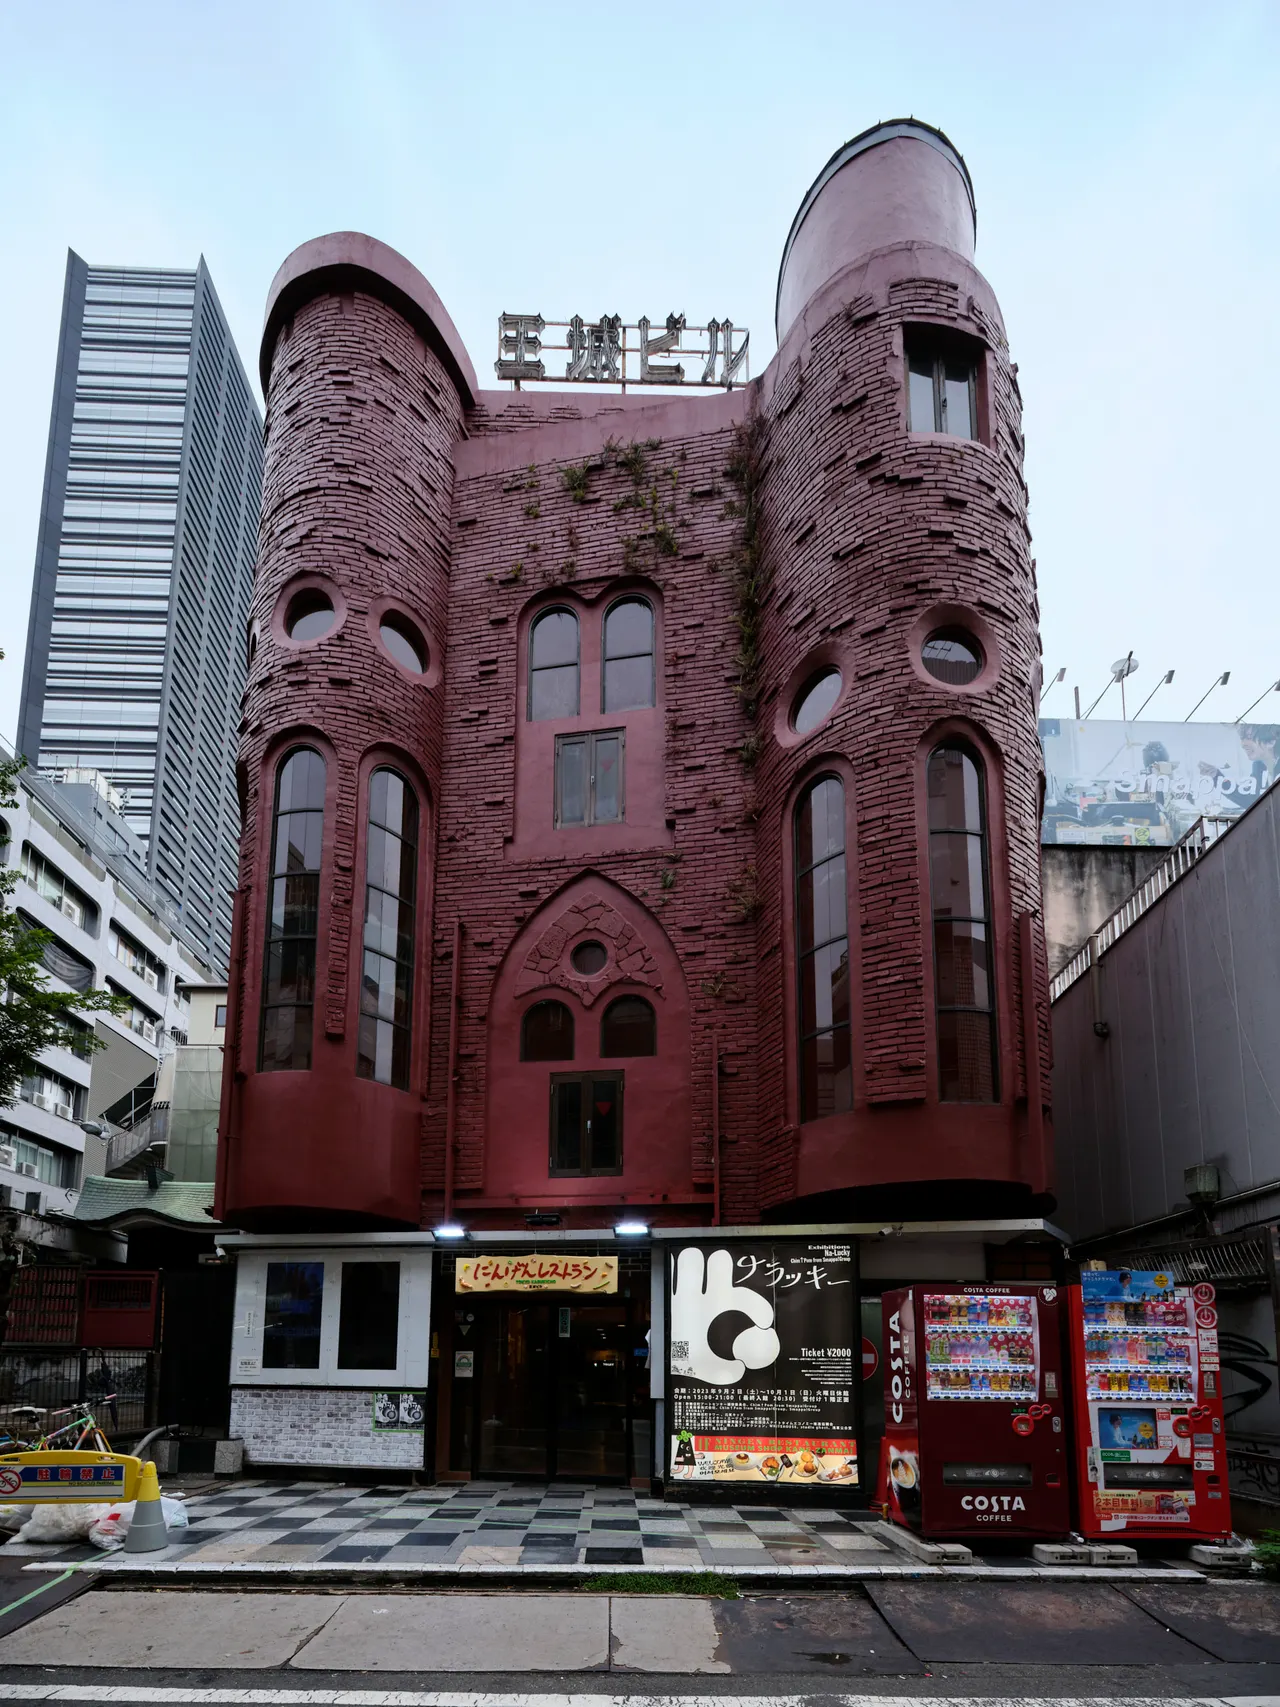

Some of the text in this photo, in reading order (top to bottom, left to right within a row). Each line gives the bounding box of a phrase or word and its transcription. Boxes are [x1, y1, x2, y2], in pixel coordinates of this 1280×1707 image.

[494, 311, 750, 386] 王城ビル
[1115, 769, 1280, 800] Smappa!
[824, 1249, 850, 1257] Na-Lucky
[473, 1261, 598, 1281] にんげんレストラン
[734, 1255, 850, 1290] ナラッキー
[801, 1347, 852, 1357] Ticket ¥2000
[889, 1310, 903, 1424] COSTA
[903, 1334, 912, 1399] COFFEE
[715, 1437, 763, 1445] NINGEN
[768, 1439, 856, 1447] RESTAURANT
[37, 1467, 115, 1480] 駐輪禁止
[961, 1495, 1026, 1513] COSTA
[976, 1514, 1012, 1522] COFFEE
